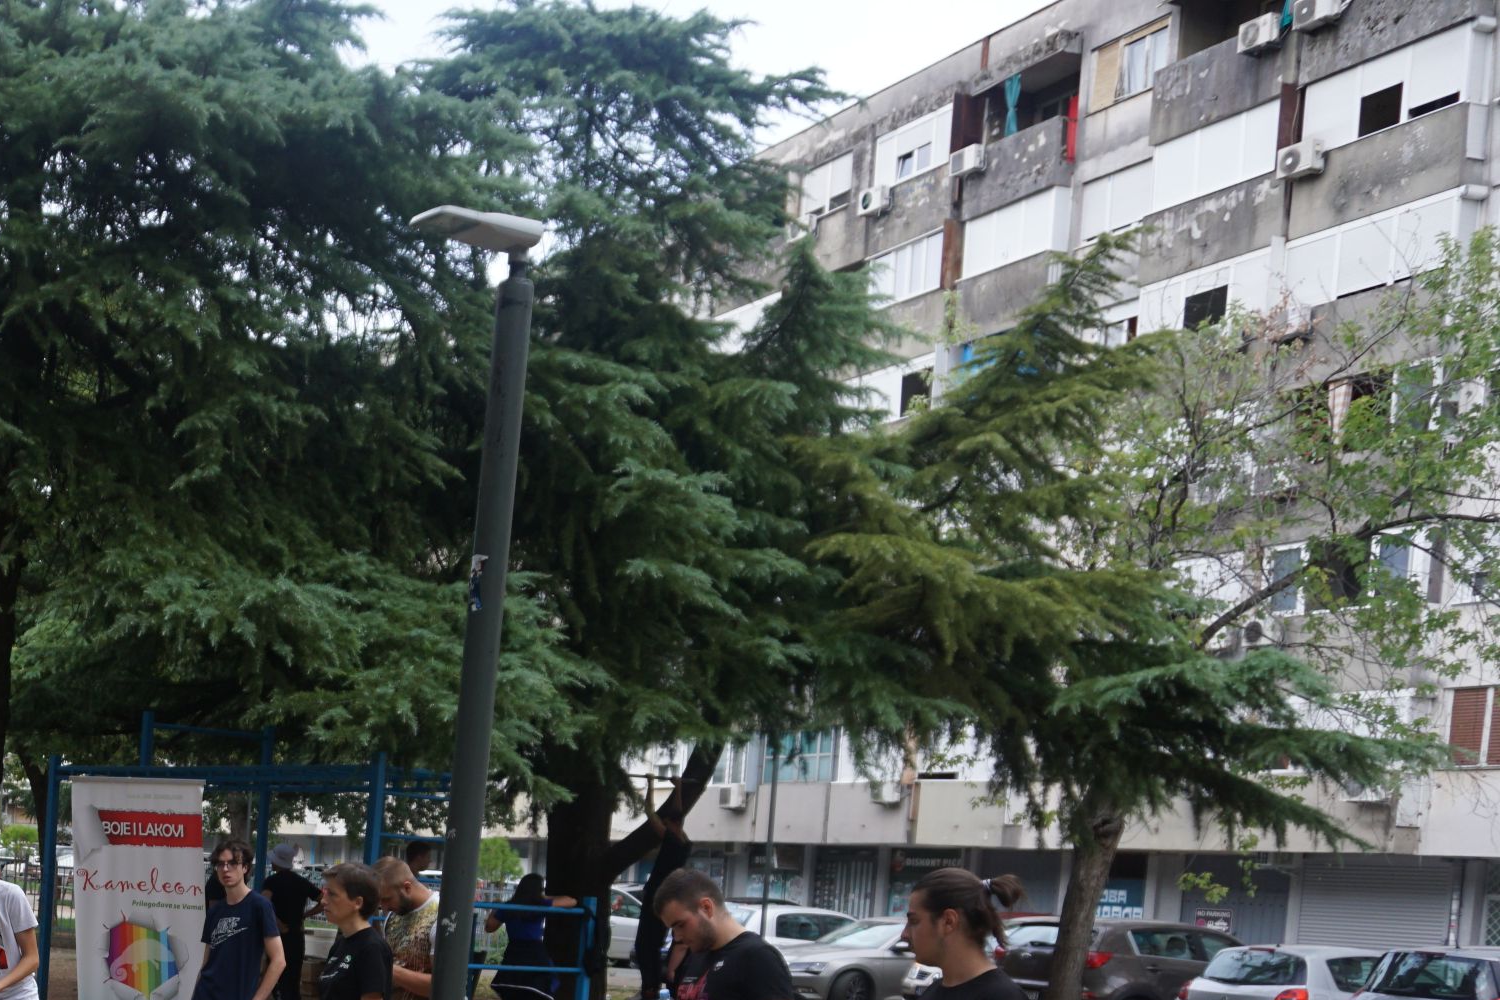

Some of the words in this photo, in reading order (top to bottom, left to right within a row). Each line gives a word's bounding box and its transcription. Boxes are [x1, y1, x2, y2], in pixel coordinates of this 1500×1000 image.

[102, 821, 131, 836] BOJE
[133, 821, 137, 836] I
[139, 822, 184, 838] LAKOVI
[77, 867, 203, 897] Kameleon
